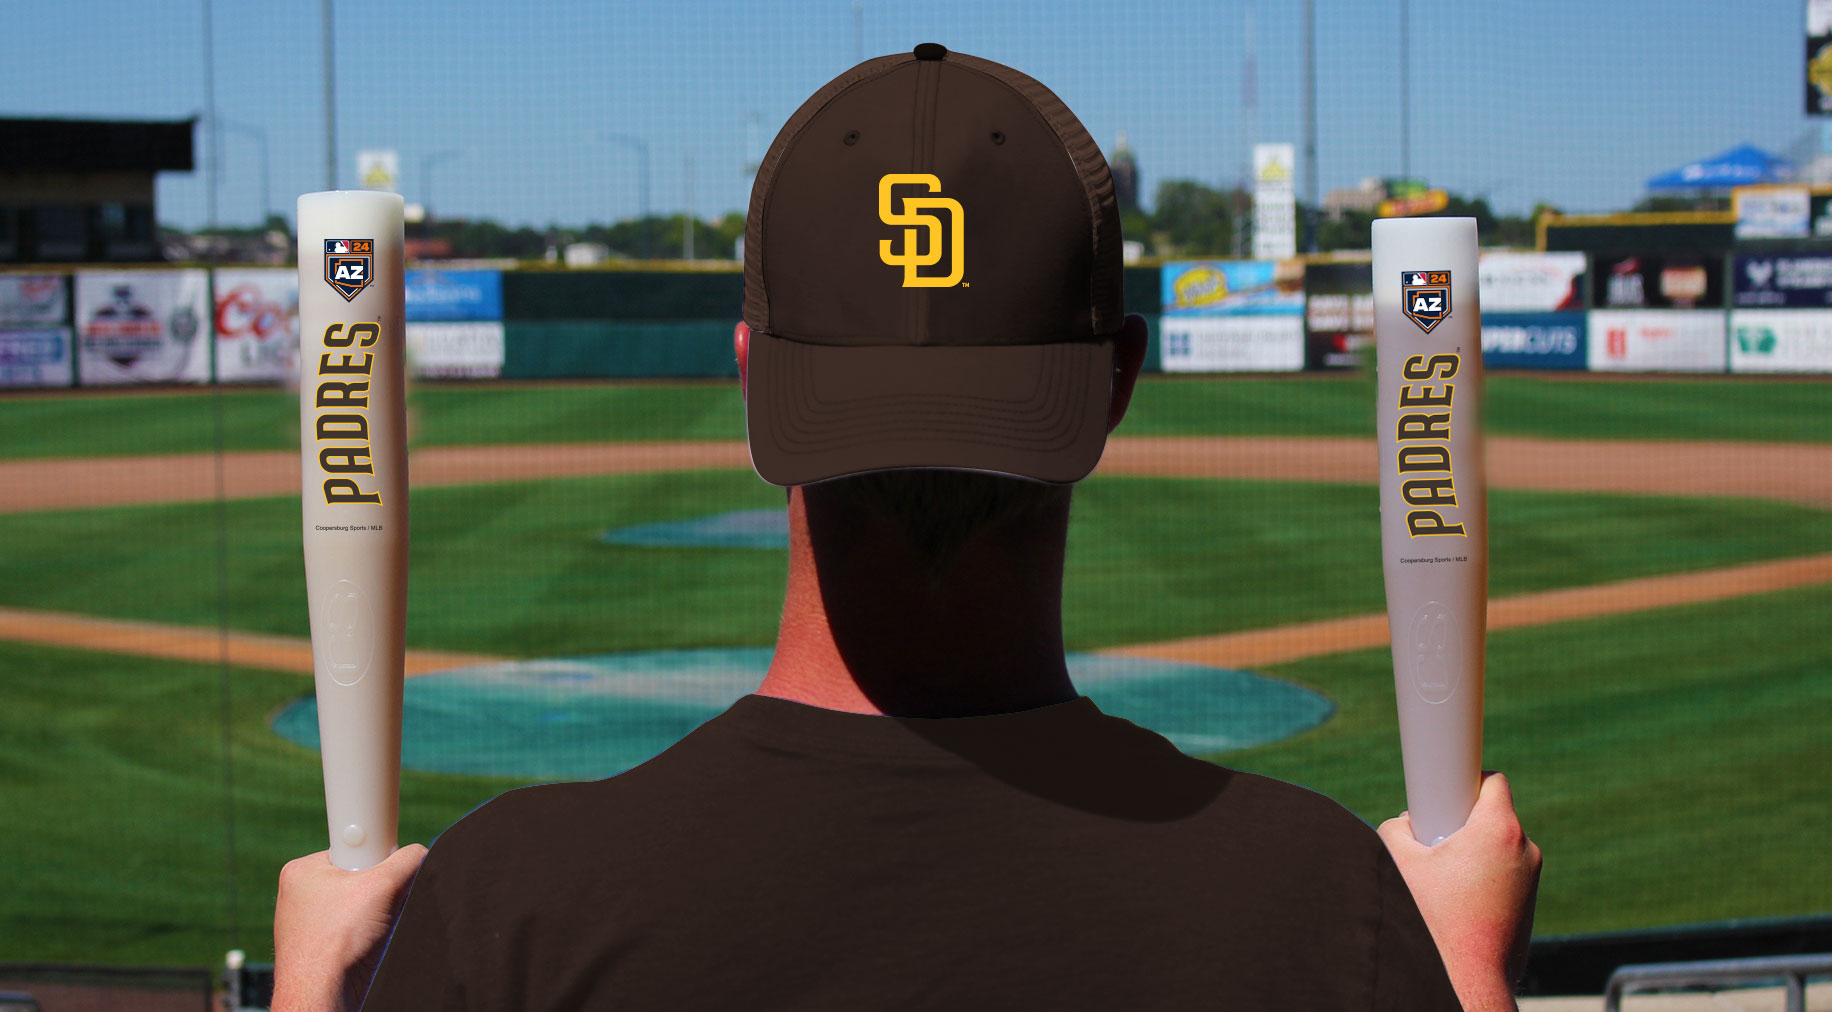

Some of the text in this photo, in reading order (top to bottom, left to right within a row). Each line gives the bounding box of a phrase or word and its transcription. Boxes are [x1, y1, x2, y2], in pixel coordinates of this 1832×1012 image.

[878, 173, 965, 288] SD
[353, 242, 369, 251] 24
[335, 266, 364, 280] AZ
[1430, 274, 1447, 283] 24
[1412, 297, 1442, 312] AZ
[315, 321, 383, 507] PADRES
[1396, 353, 1468, 539] PADRES
